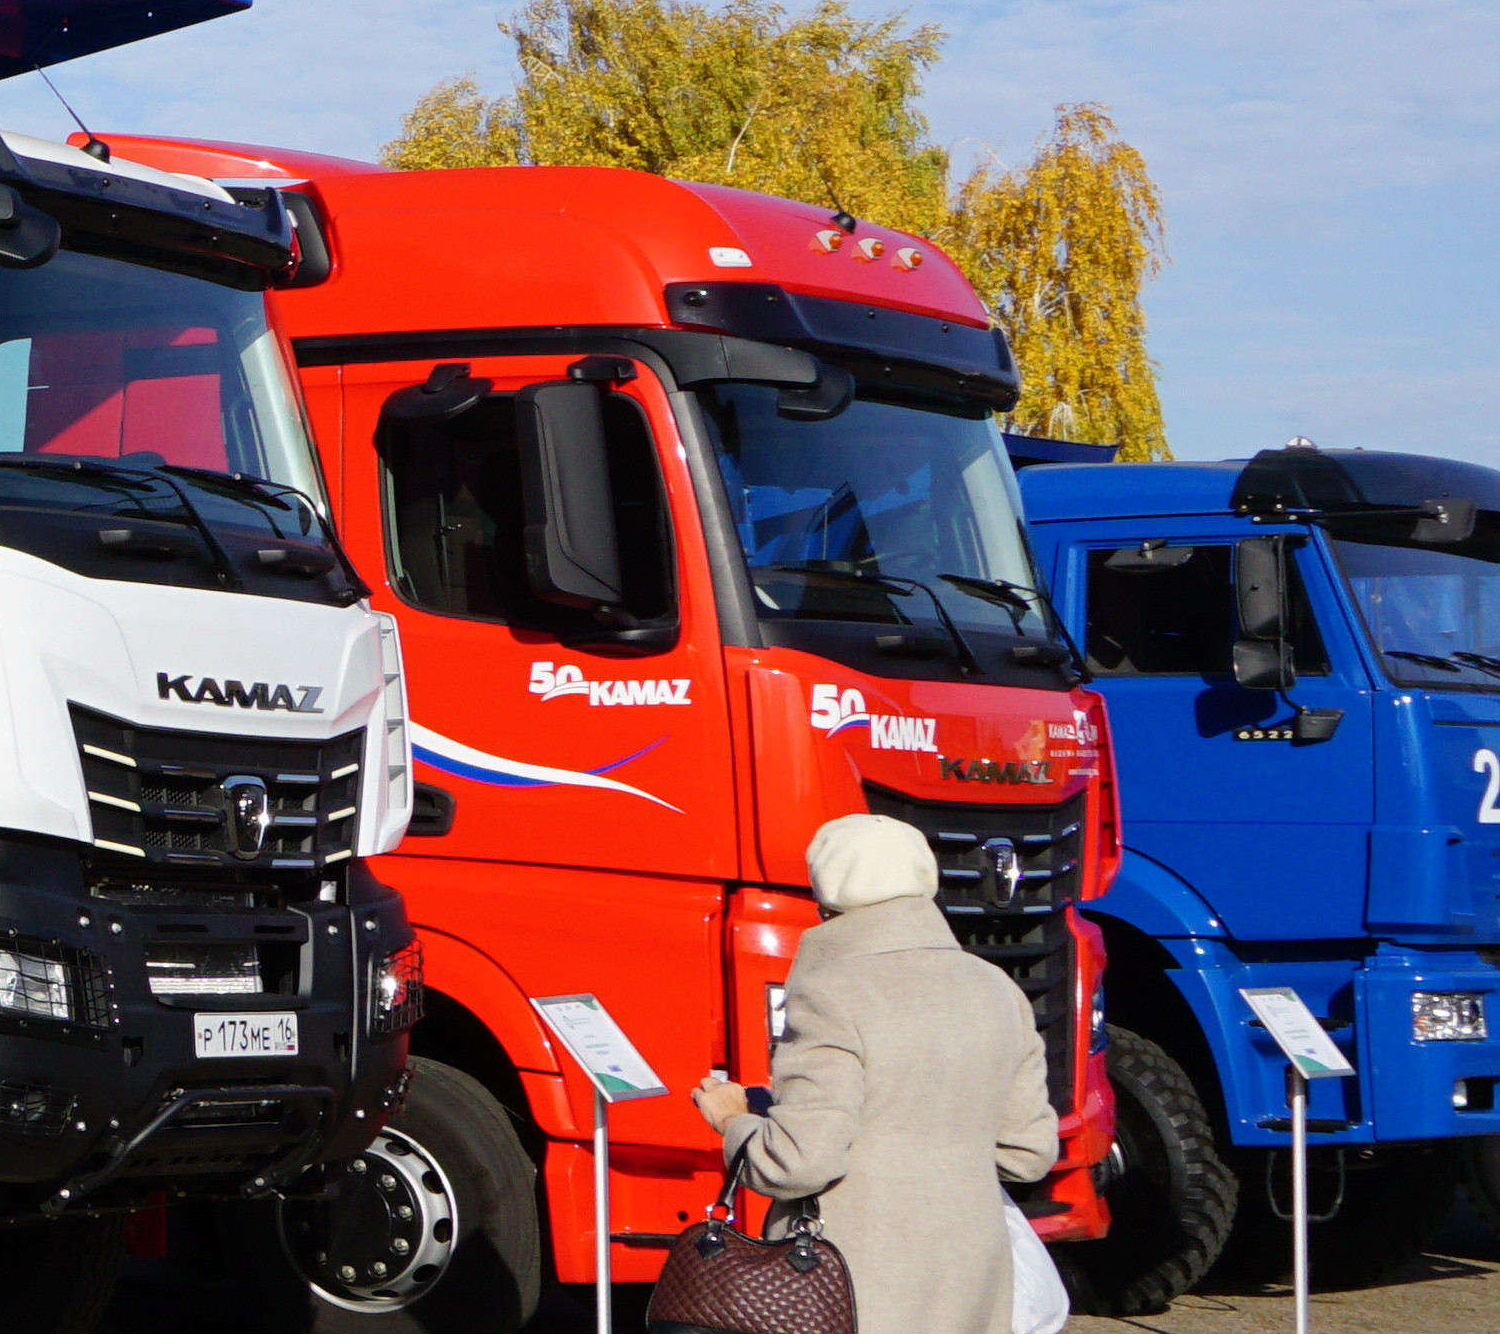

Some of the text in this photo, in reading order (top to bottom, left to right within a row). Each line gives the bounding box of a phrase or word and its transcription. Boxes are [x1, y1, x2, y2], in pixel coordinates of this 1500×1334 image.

[156, 672, 325, 714] KAMAZ
[528, 661, 692, 706] 50 KAMAZ
[810, 684, 938, 753] 50 KAMAZ
[936, 754, 1055, 785] KAMAZ
